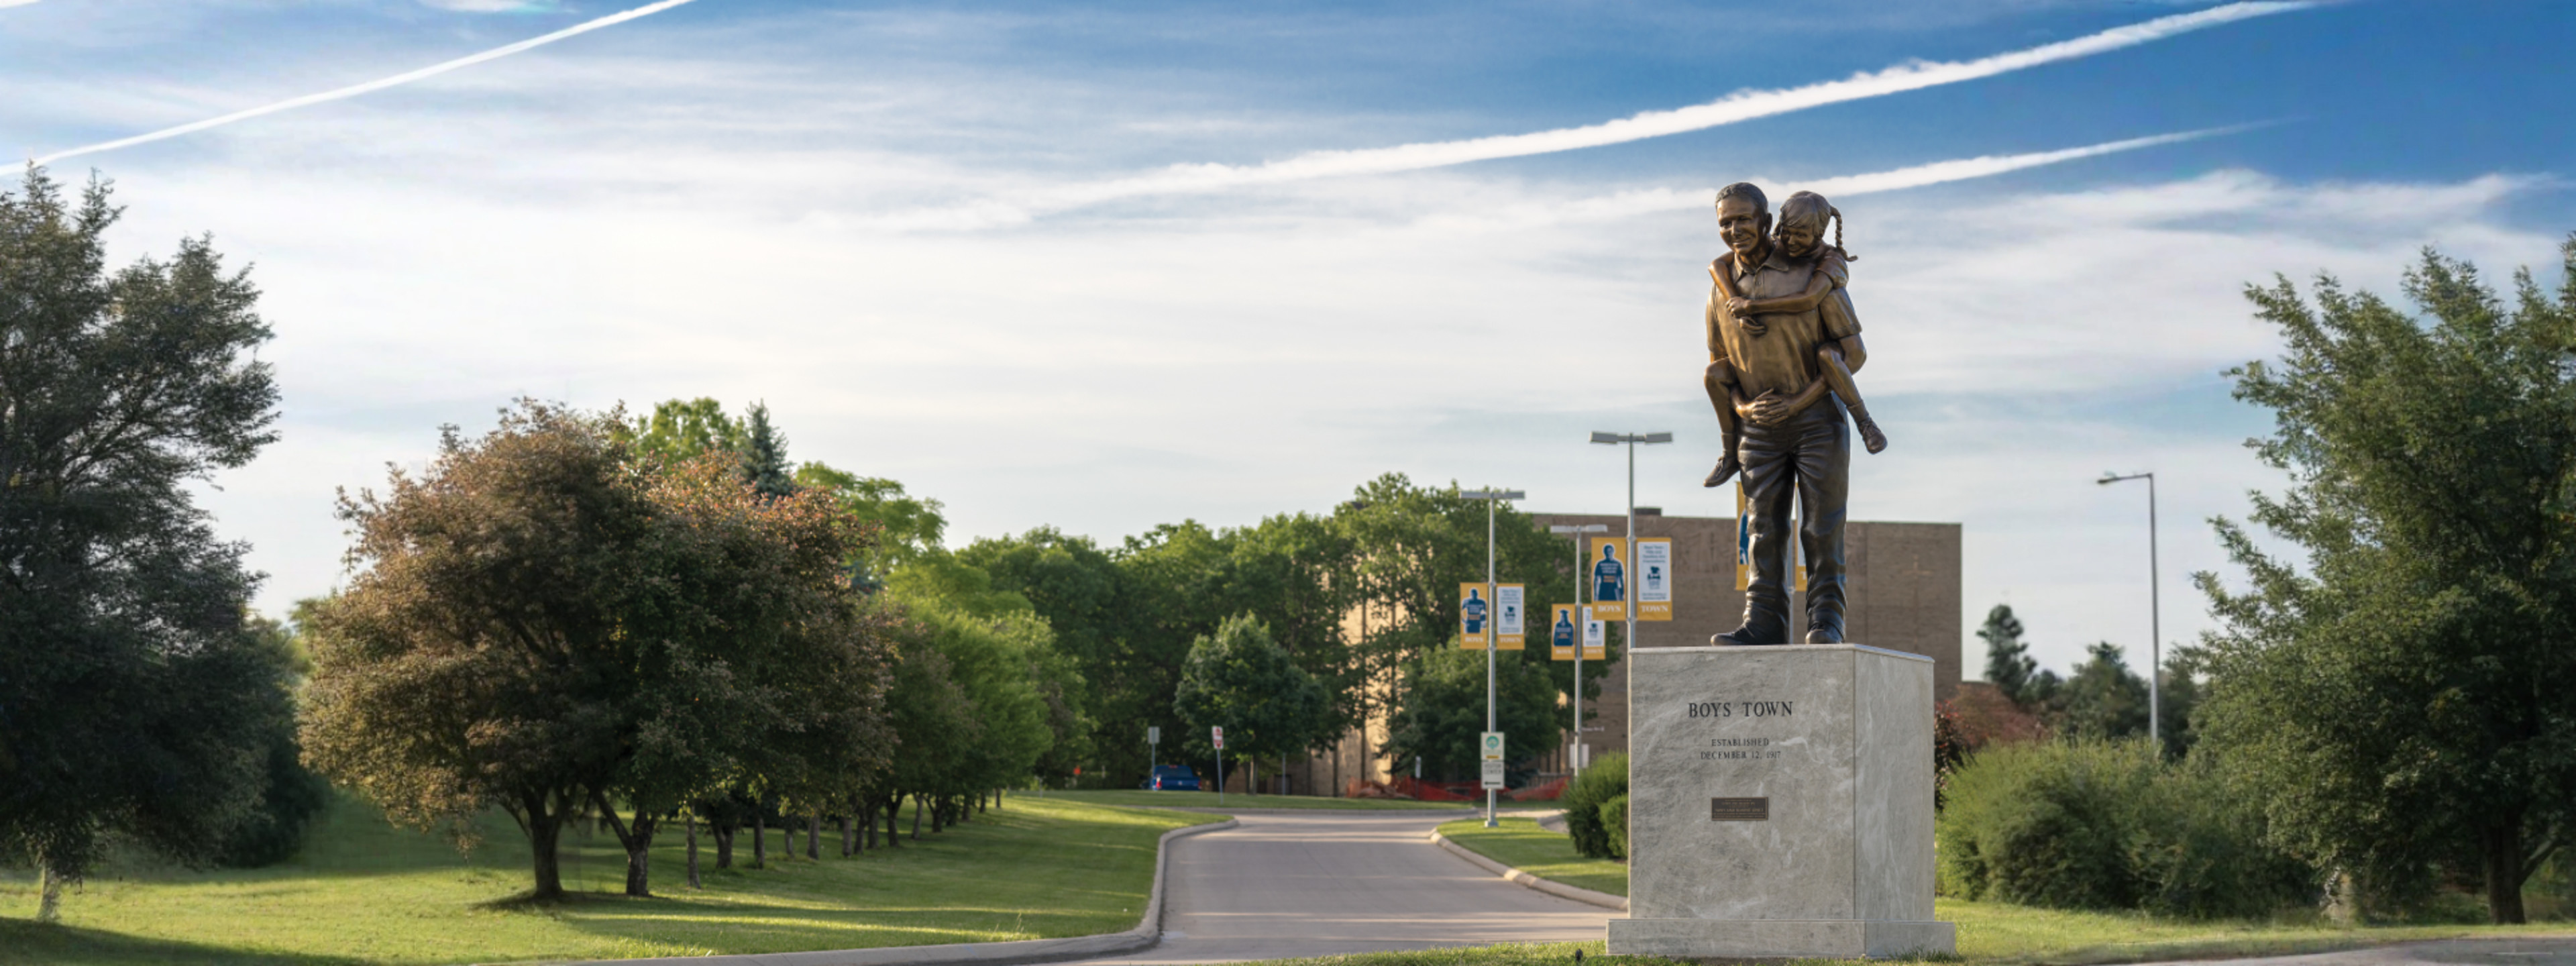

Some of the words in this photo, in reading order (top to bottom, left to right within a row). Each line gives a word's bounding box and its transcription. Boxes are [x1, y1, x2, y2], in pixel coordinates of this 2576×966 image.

[1688, 702, 1731, 718] BOYS
[1743, 701, 1793, 717] TOWN
[1711, 739, 1769, 747] ESTABLISHED
[1701, 751, 1747, 760] DECEMBER
[1751, 751, 1762, 759] 12,
